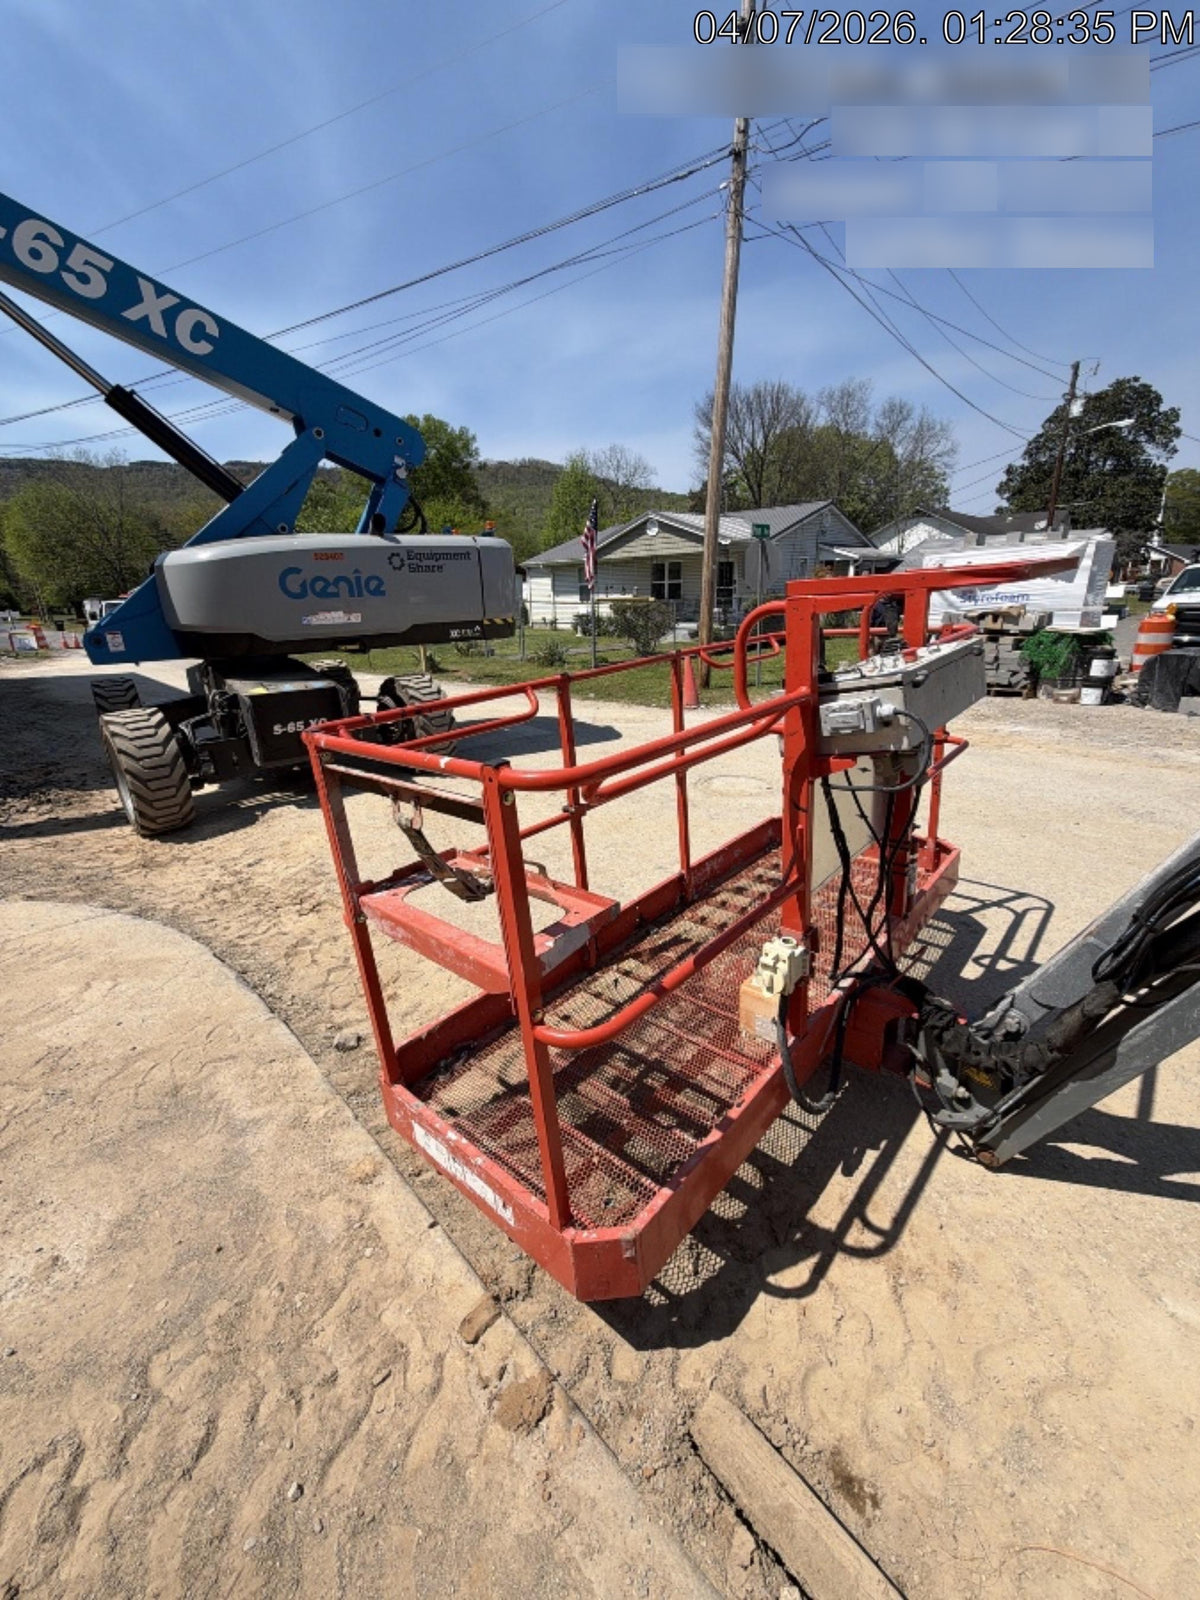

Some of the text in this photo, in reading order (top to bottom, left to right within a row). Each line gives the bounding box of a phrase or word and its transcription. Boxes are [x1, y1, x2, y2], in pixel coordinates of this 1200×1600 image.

[120, 275, 219, 355] XC
[406, 550, 471, 562] Equipment
[408, 563, 444, 573] Share
[278, 566, 386, 599] Genie
[273, 721, 304, 735] S-65
